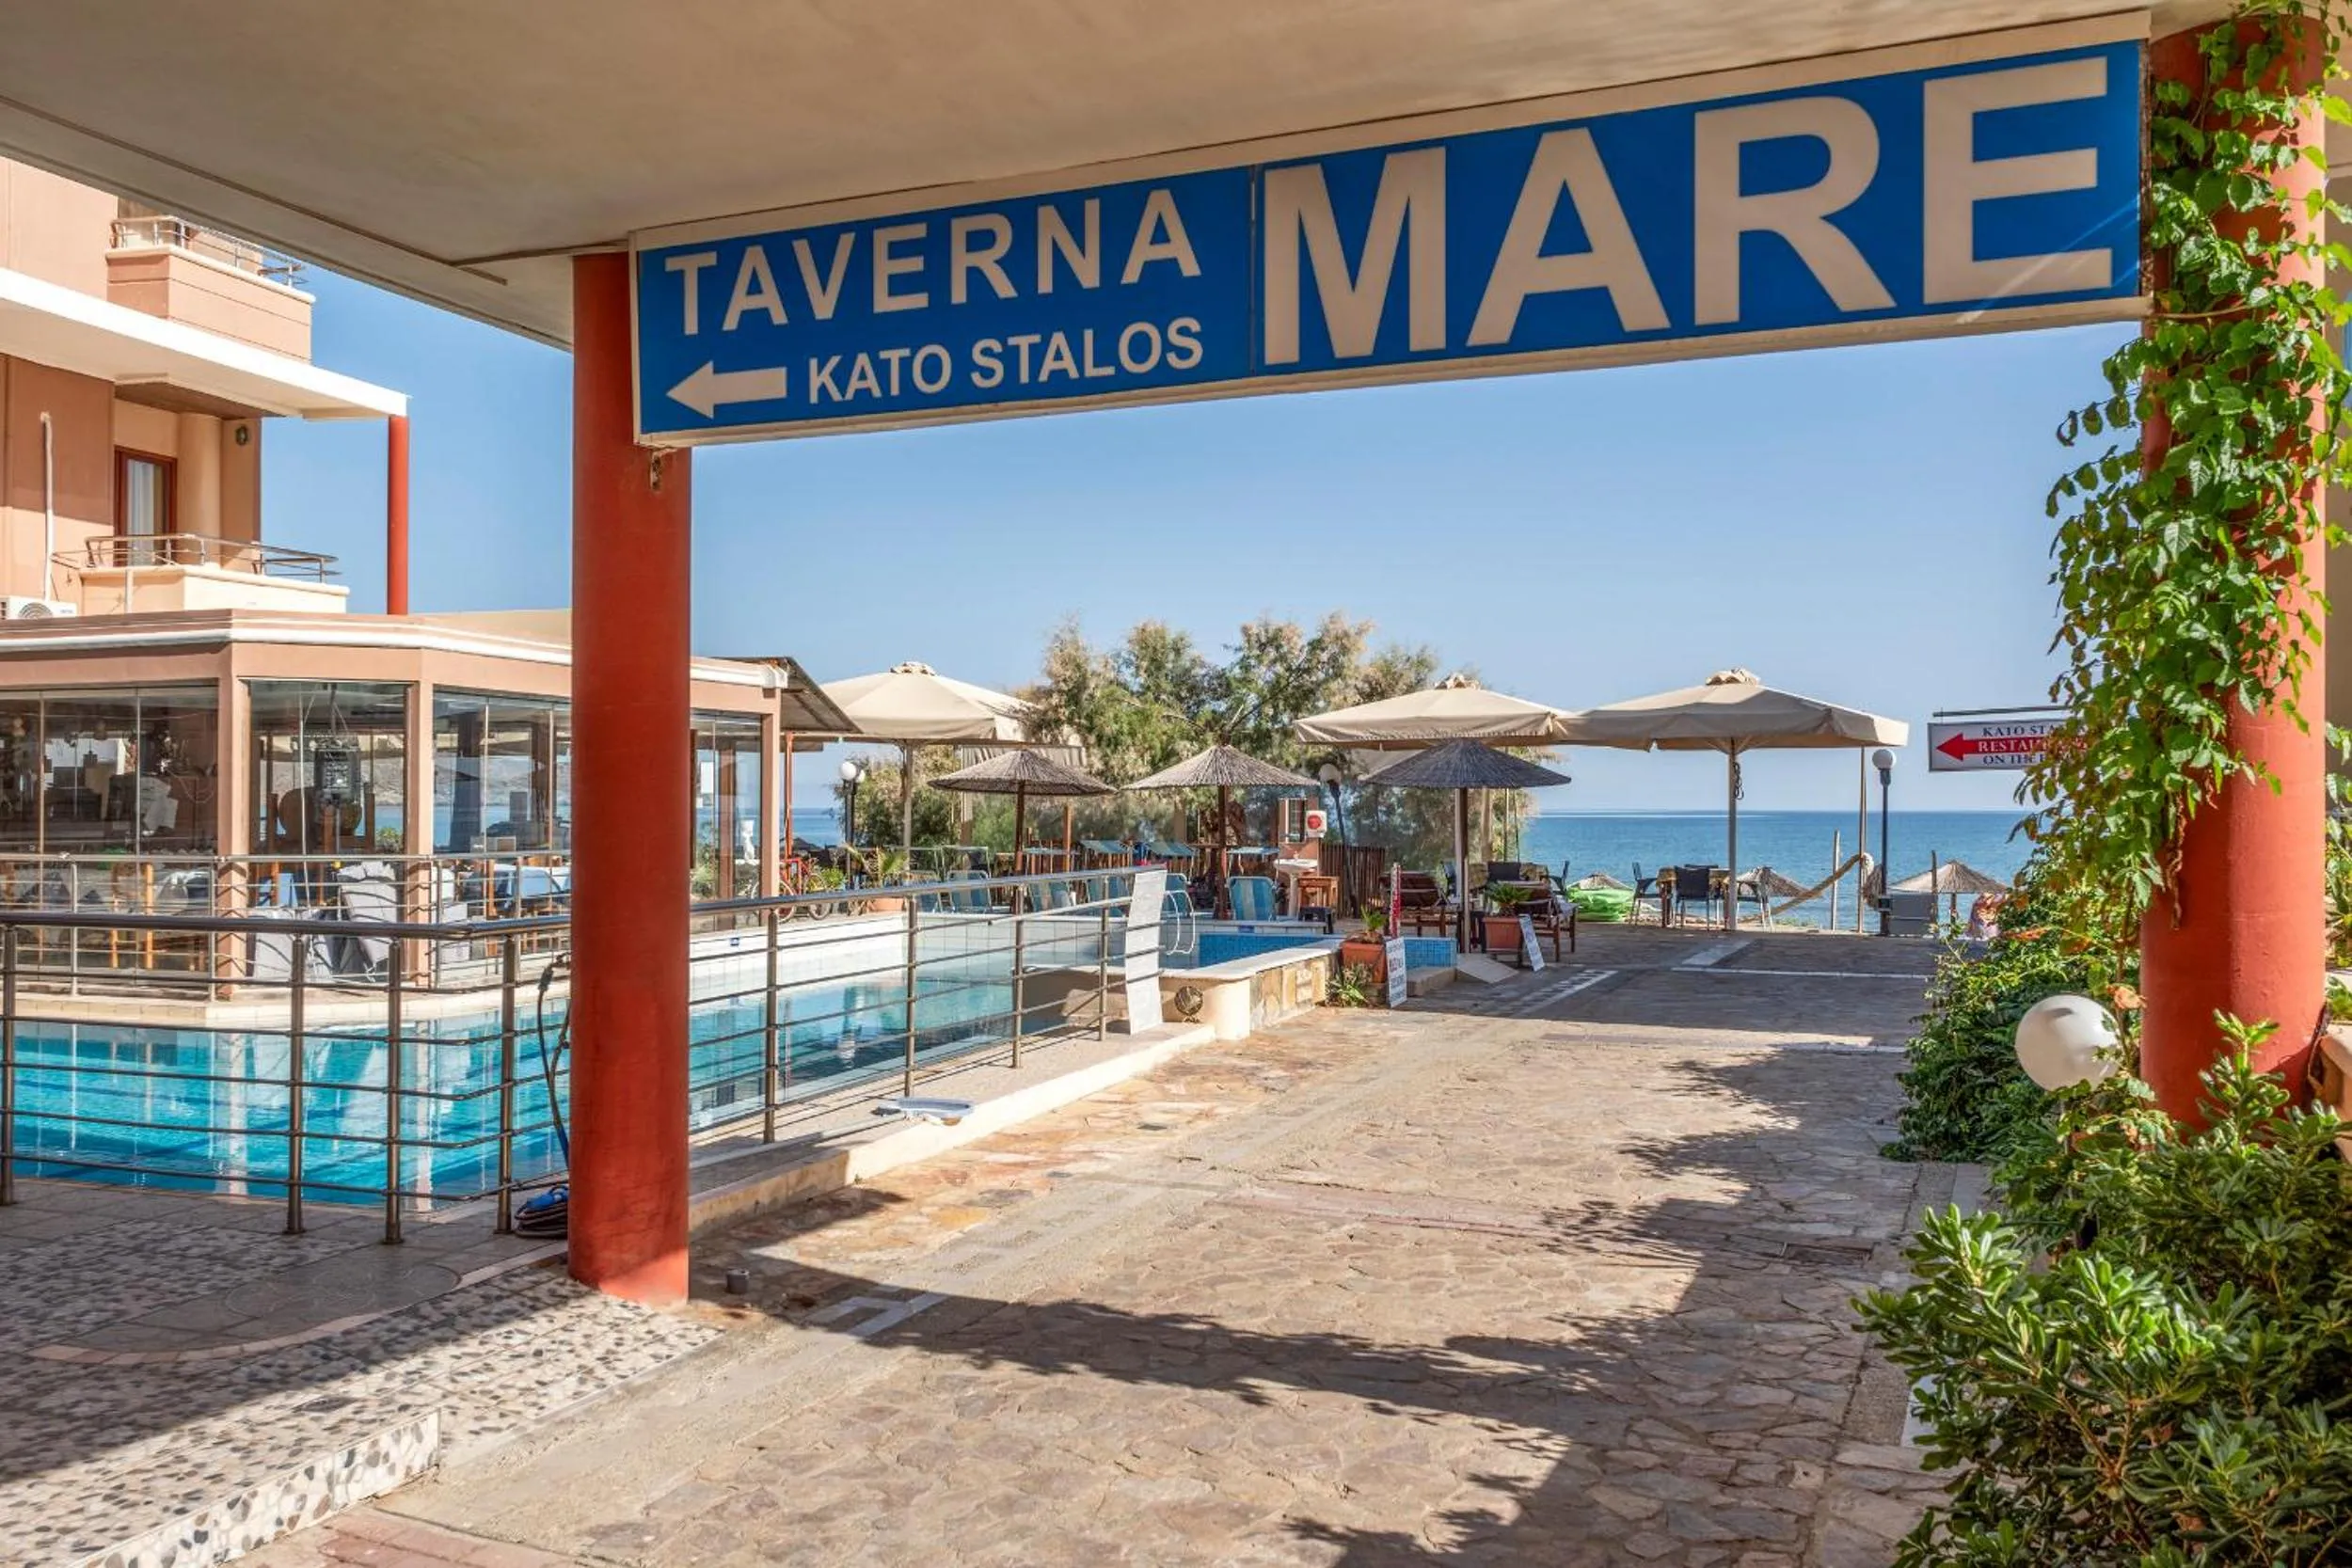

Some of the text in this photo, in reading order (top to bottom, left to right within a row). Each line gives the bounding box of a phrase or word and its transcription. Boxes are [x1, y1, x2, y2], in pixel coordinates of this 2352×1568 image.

[1263, 56, 2114, 366] MARE
[664, 189, 1202, 335] TAVERNA
[808, 317, 1204, 404] KATO STALOS
[1982, 726, 2025, 737] KATO
[1982, 755, 2005, 765] ON
